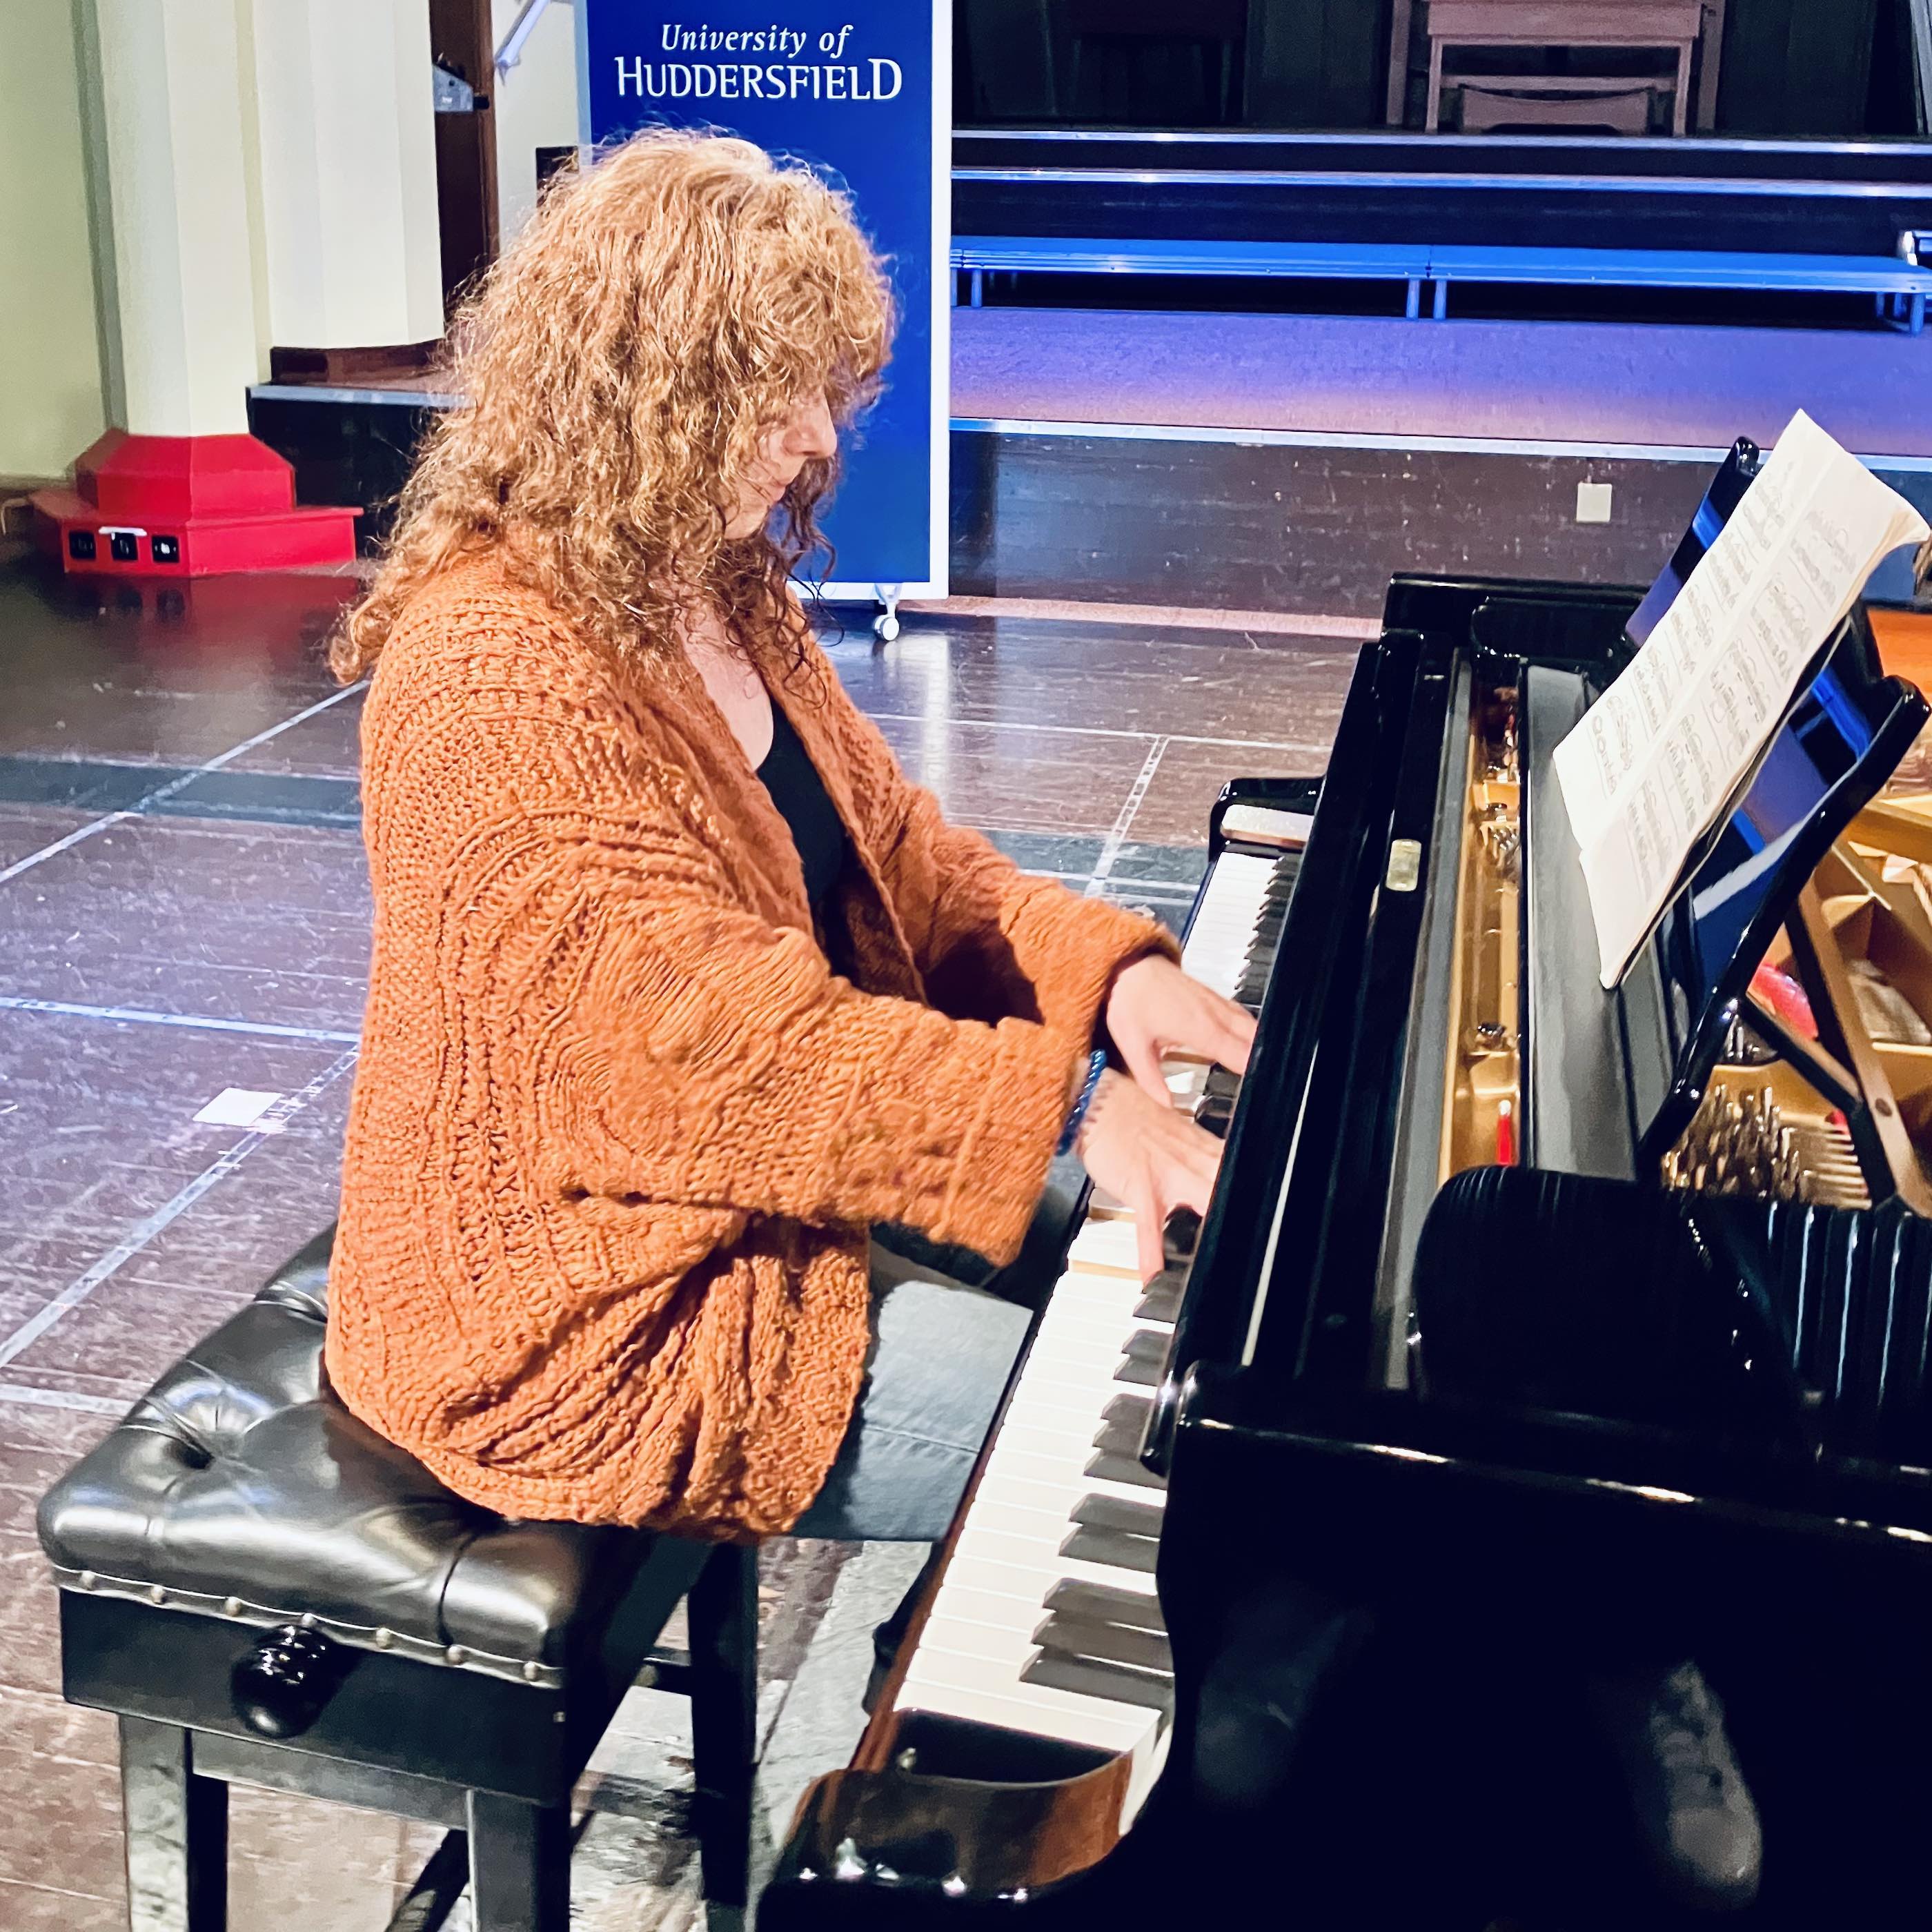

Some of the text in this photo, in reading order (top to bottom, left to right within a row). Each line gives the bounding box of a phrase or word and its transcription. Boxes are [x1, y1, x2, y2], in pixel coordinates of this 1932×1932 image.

[662, 24, 854, 58] University of
[614, 57, 902, 99] HUDDERSFIELD
